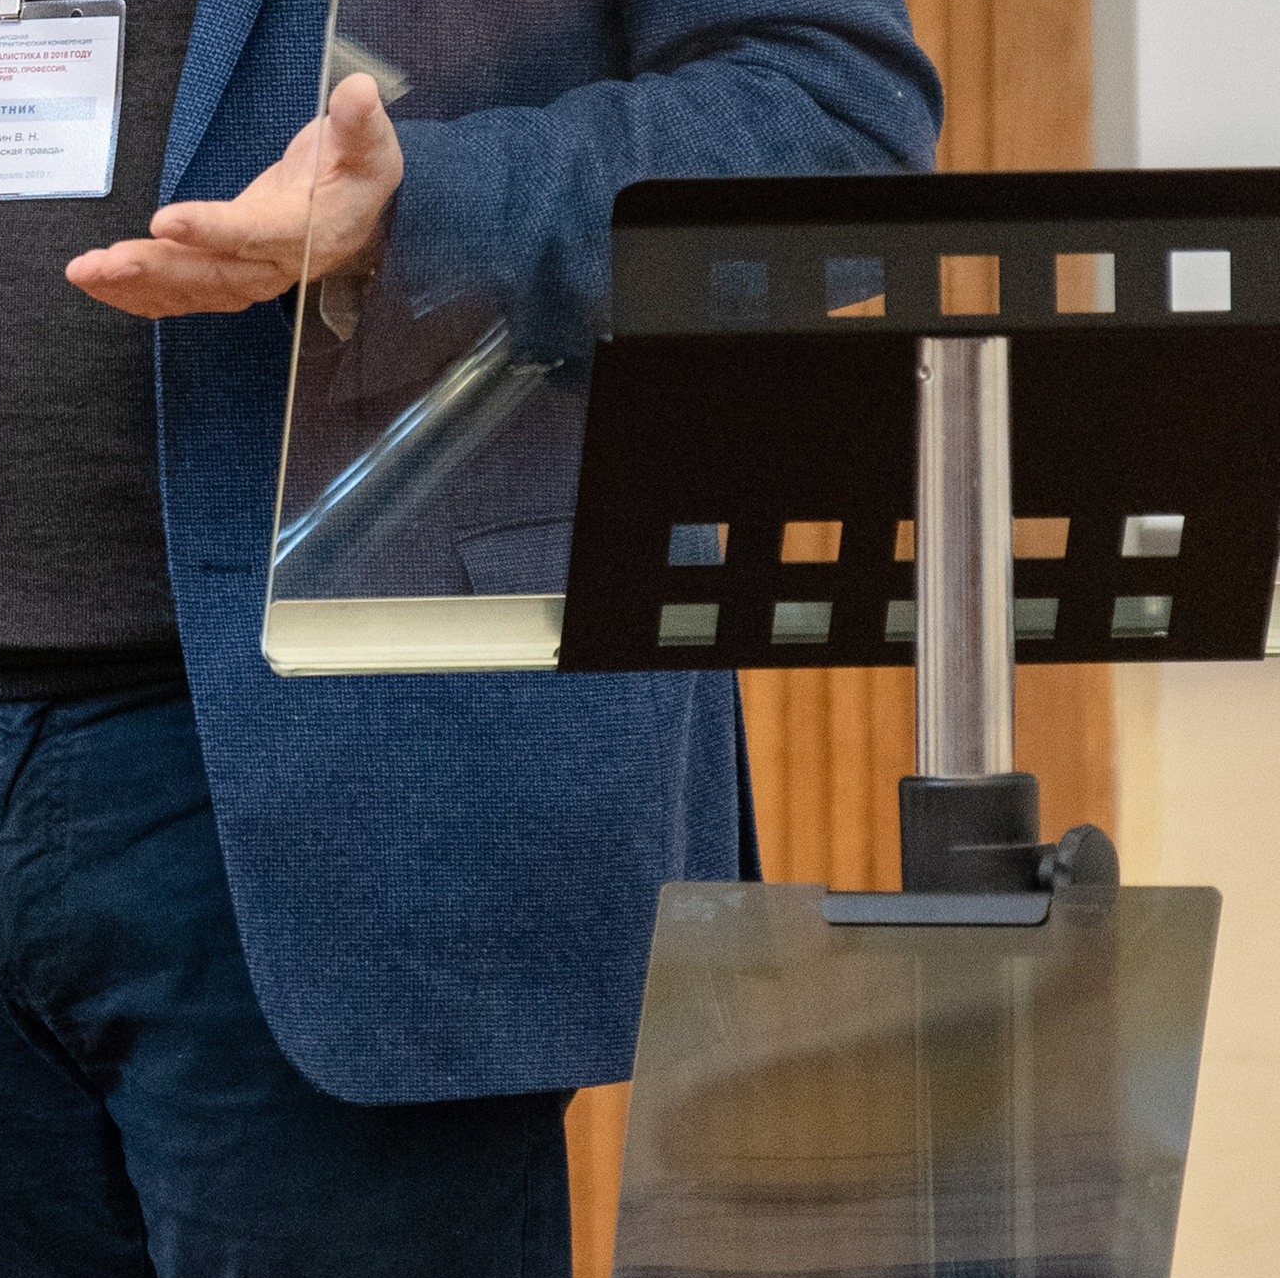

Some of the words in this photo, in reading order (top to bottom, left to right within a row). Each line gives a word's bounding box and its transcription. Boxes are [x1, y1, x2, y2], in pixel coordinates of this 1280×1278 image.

[43, 51, 49, 59] В
[50, 51, 69, 60] 2018
[70, 50, 93, 59] ГОДУ
[21, 65, 68, 73] ПРОФЕССИЯ,
[14, 132, 25, 142] В.
[28, 132, 39, 141] Н.
[24, 146, 65, 156] правда»
